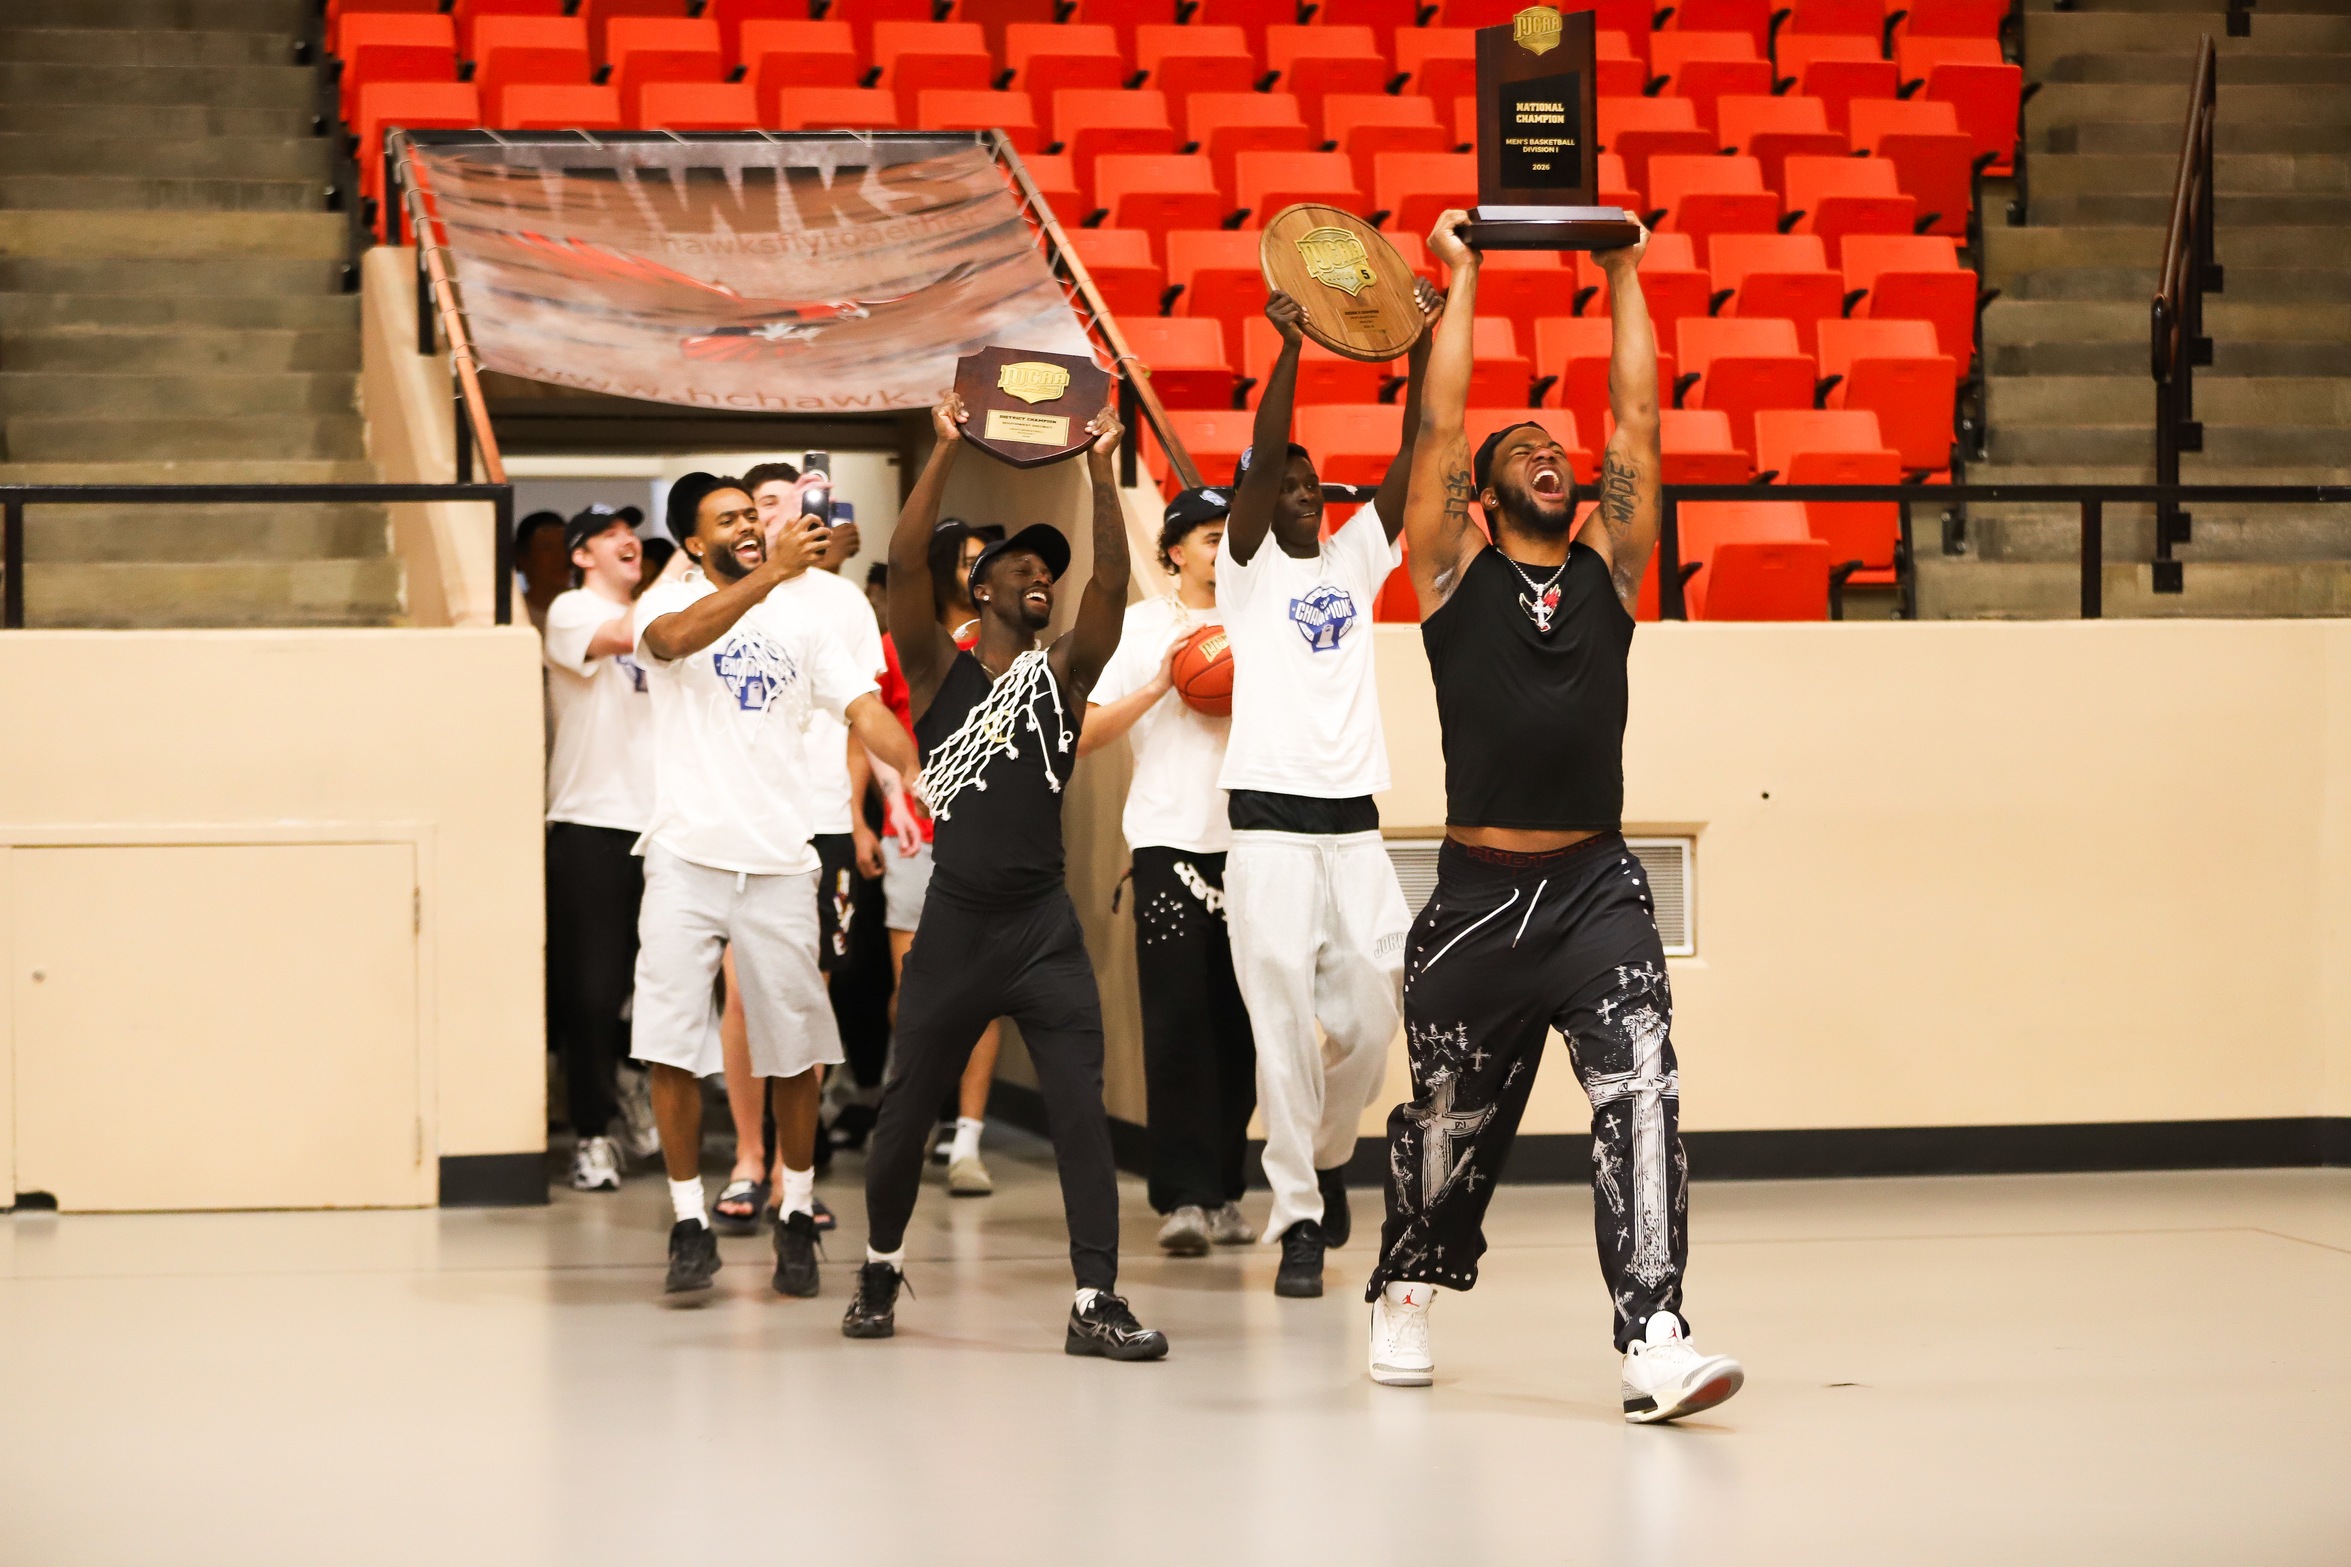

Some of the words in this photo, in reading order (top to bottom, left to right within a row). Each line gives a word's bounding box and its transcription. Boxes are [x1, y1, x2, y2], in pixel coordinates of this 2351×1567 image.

[1516, 16, 1560, 38] NJCAA
[1516, 103, 1564, 112] NATIONAL
[1516, 114, 1564, 124] CHAMPION
[1360, 269, 1371, 280] 5
[1002, 367, 1067, 386] NJCAA
[1444, 470, 1471, 526] SELF
[1606, 459, 1636, 525] MADE
